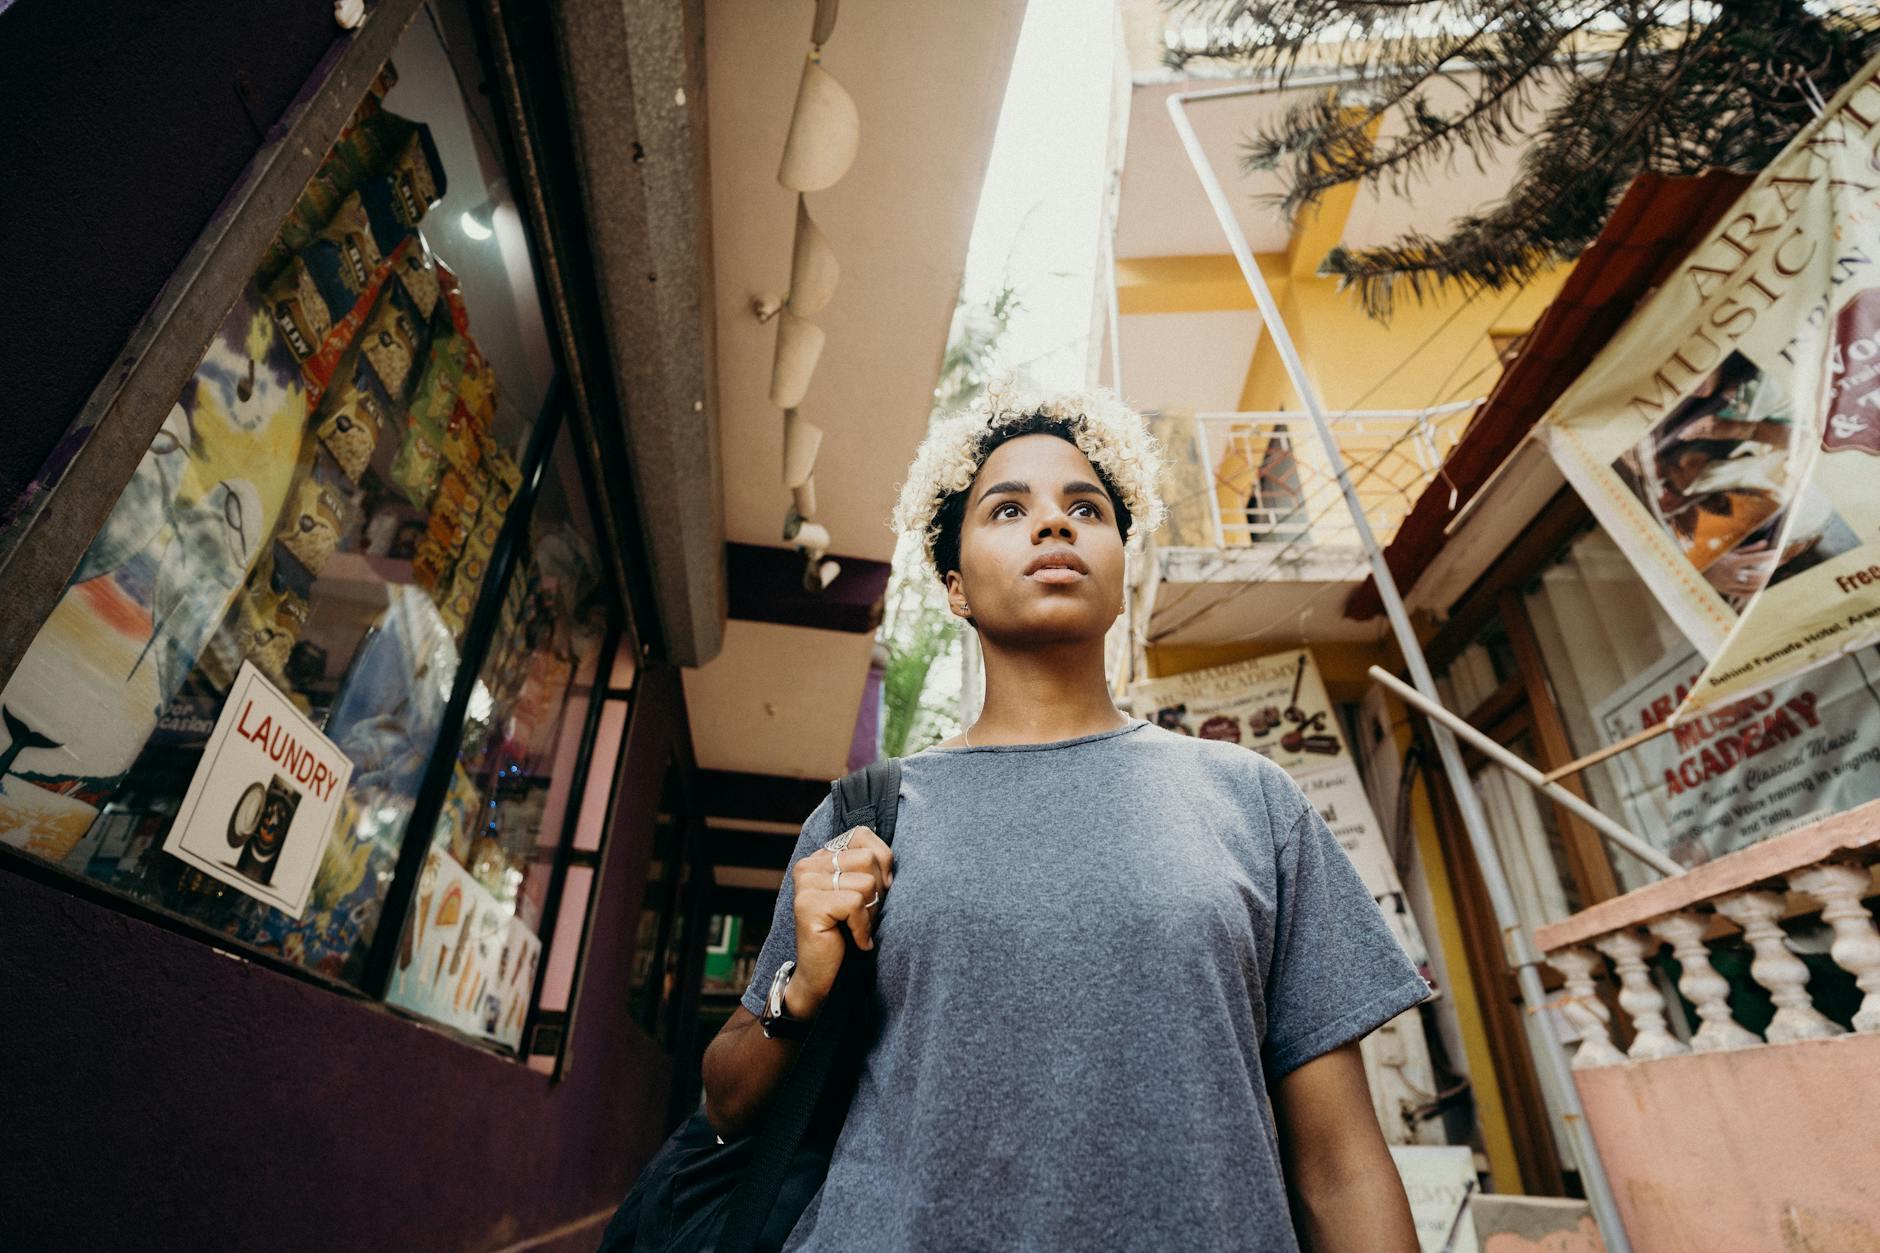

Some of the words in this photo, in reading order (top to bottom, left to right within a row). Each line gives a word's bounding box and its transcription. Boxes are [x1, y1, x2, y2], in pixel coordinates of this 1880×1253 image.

[1688, 74, 1880, 300] ARAM
[1628, 226, 1818, 424] MUSIC
[1709, 663, 1754, 687] Behind
[237, 699, 339, 803] LAUNDRY
[1664, 692, 1820, 798] ACADEMY
[1769, 776, 1816, 803] training
[1808, 729, 1859, 760] Music
